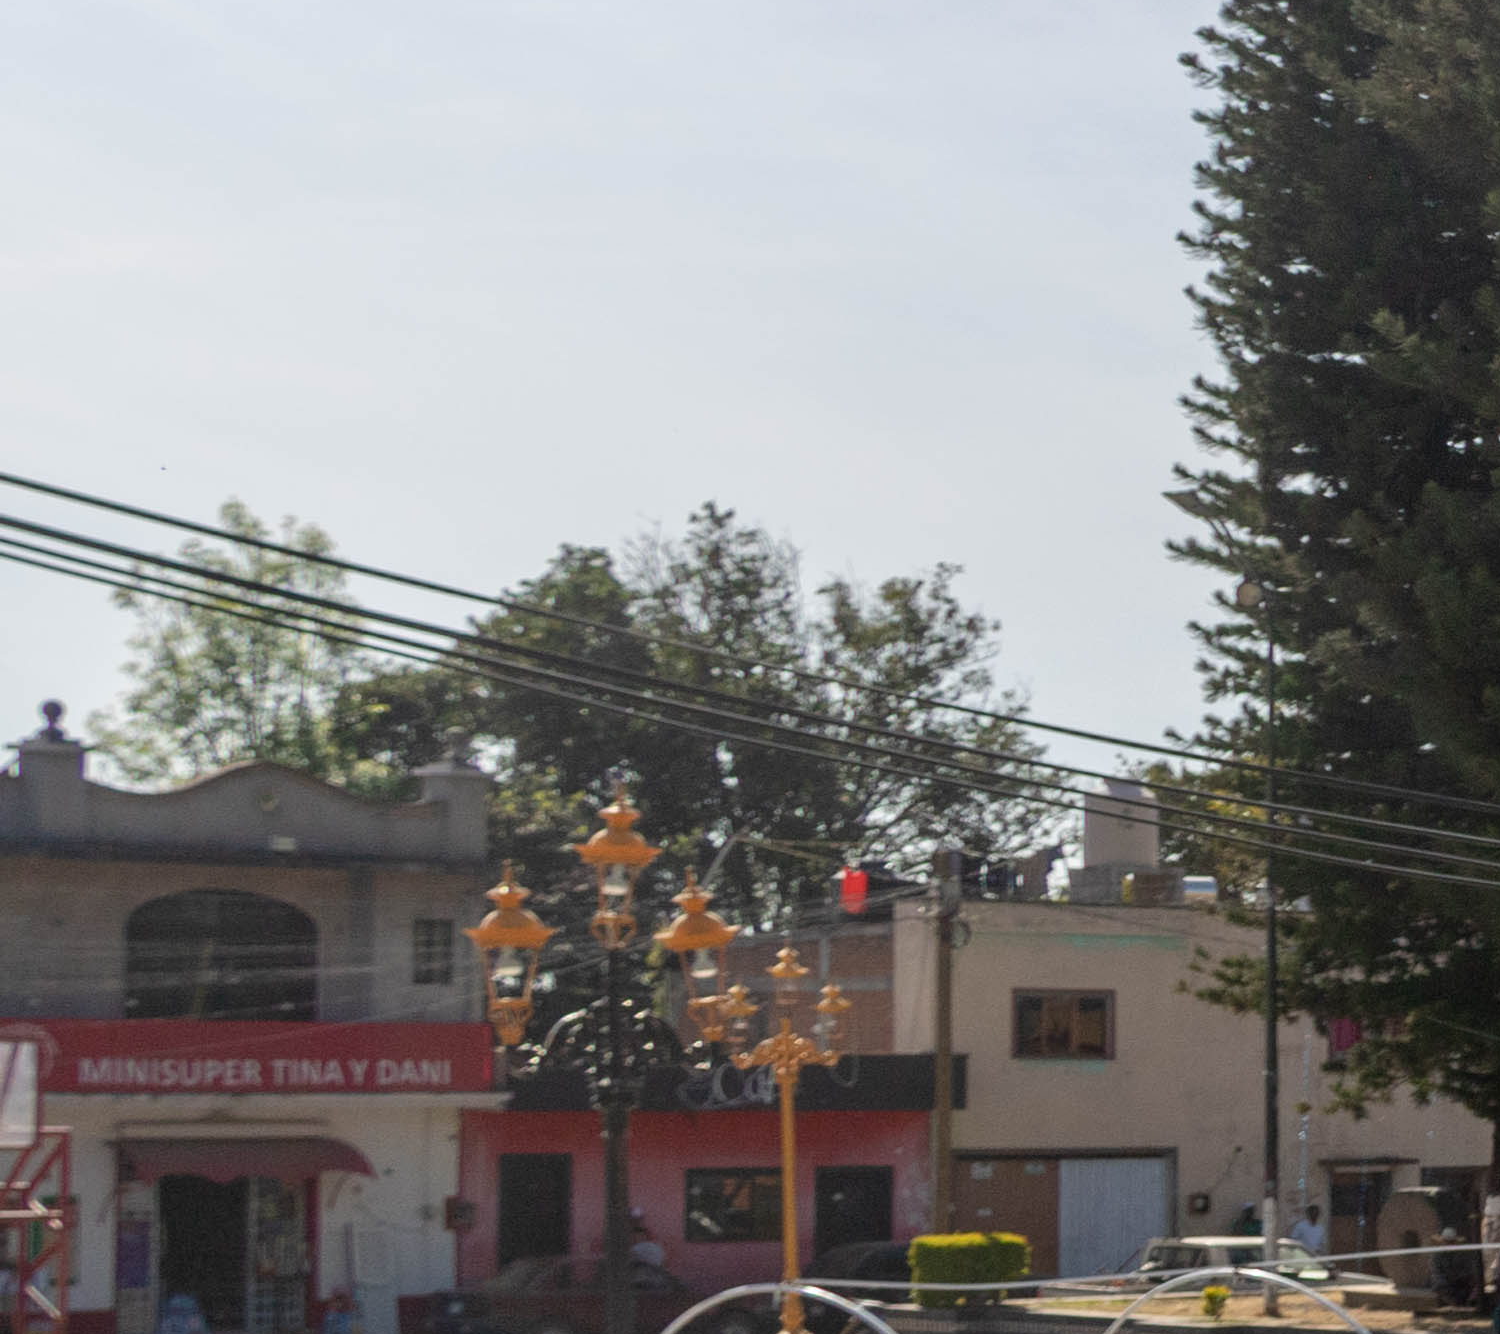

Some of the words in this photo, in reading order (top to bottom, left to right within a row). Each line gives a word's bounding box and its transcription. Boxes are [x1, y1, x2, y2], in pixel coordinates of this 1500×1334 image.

[78, 1057, 263, 1086] MINISUPER
[270, 1058, 343, 1085] TINA
[346, 1058, 370, 1085] Y
[375, 1058, 453, 1085] DANI
